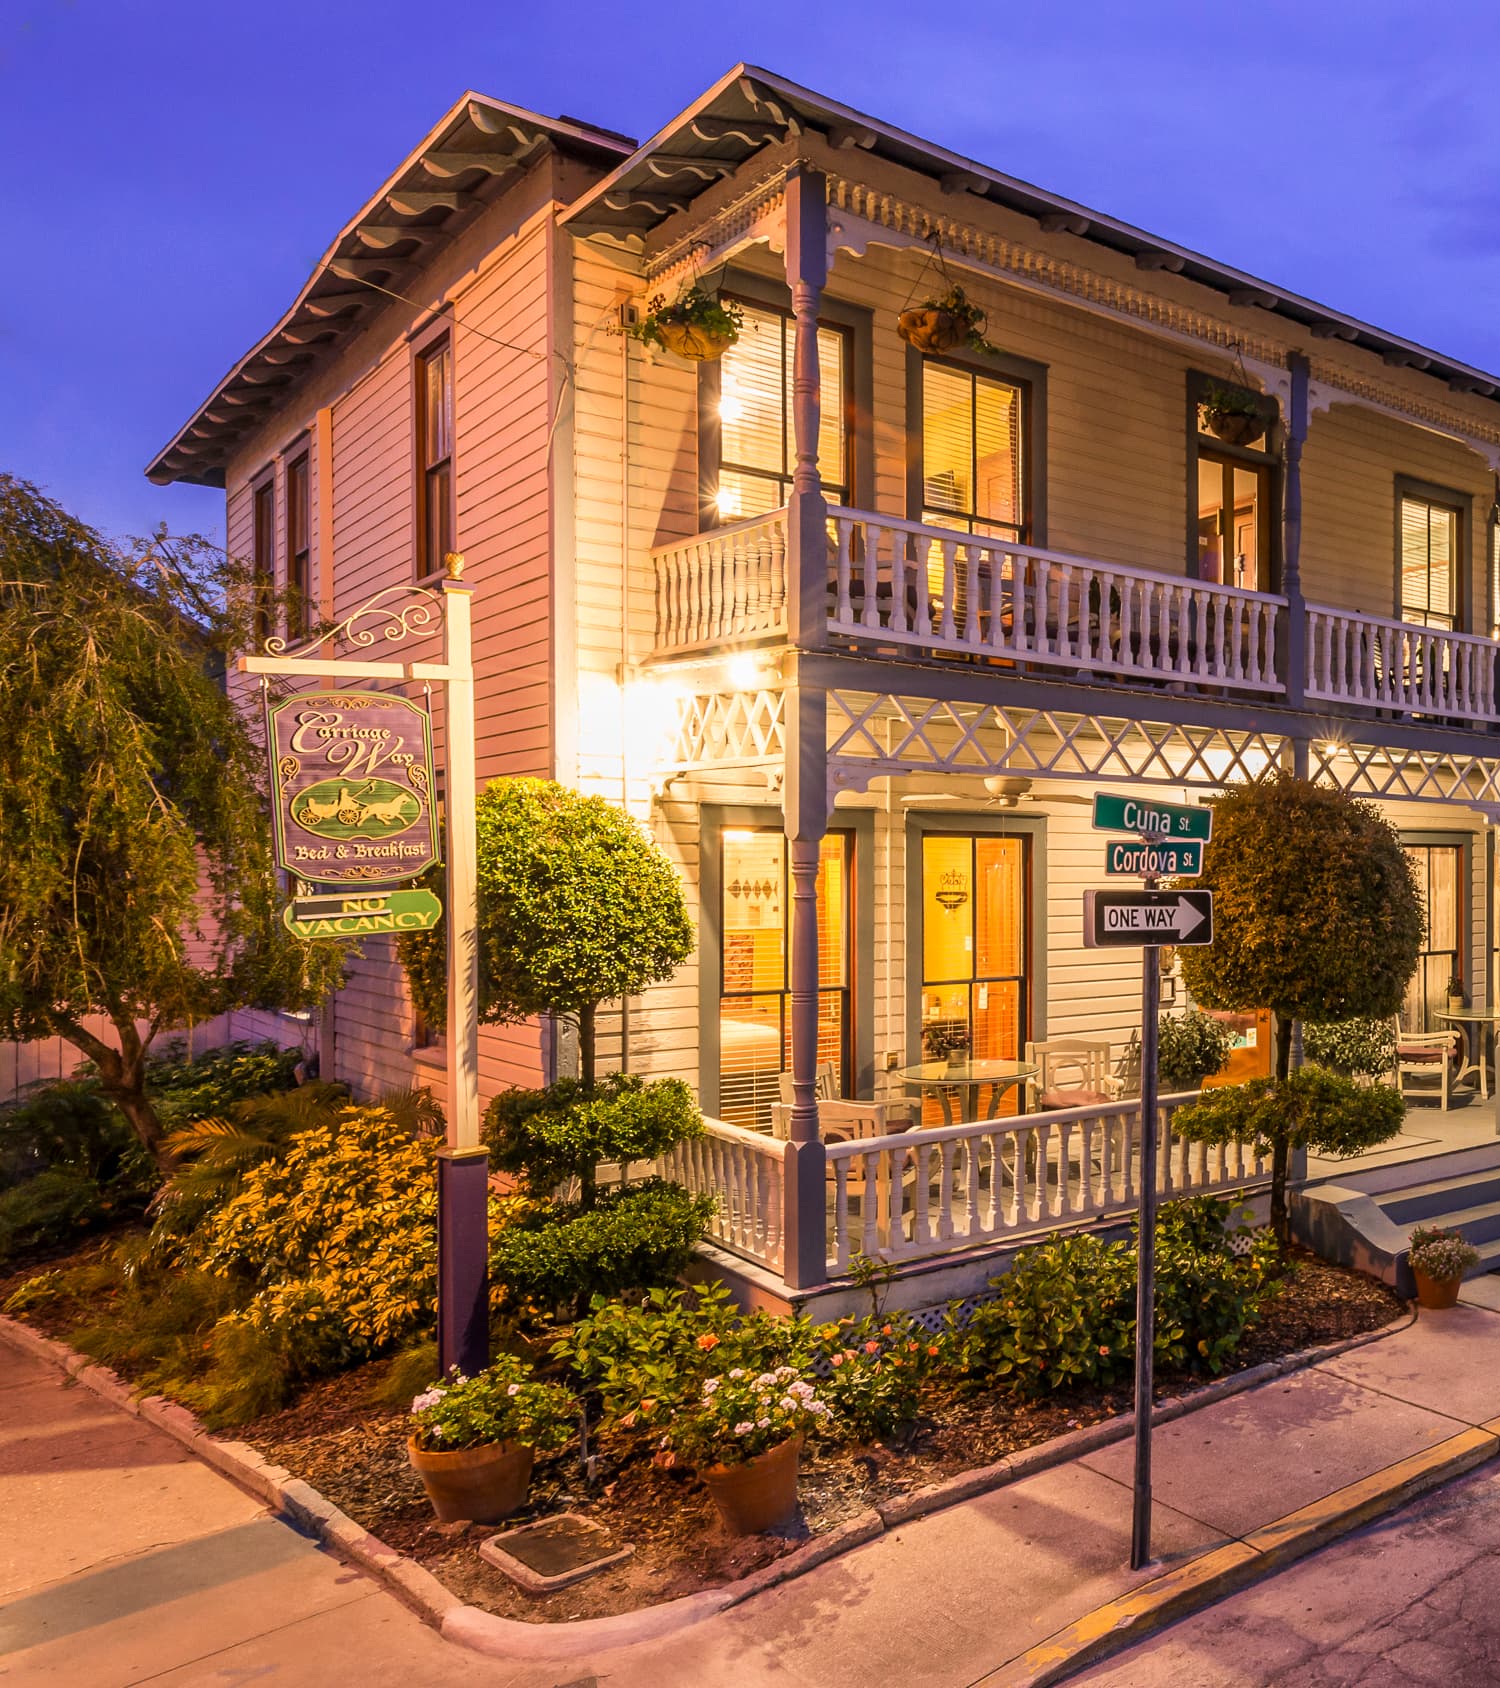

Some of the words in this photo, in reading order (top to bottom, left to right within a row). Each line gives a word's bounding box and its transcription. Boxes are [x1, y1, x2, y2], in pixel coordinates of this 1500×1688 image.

[290, 711, 391, 752] Carriage
[326, 736, 414, 776] Way
[1123, 802, 1171, 833] Cuna
[1178, 816, 1191, 831] St.
[294, 845, 331, 860] Bed
[335, 845, 350, 858] &
[353, 841, 426, 859] Breakfast
[1113, 845, 1177, 871] Cordova
[1183, 852, 1194, 867] St.
[341, 898, 386, 912] NO
[295, 912, 434, 935] VACANCY
[1108, 908, 1139, 928] ONE
[1145, 908, 1176, 928] WAY
